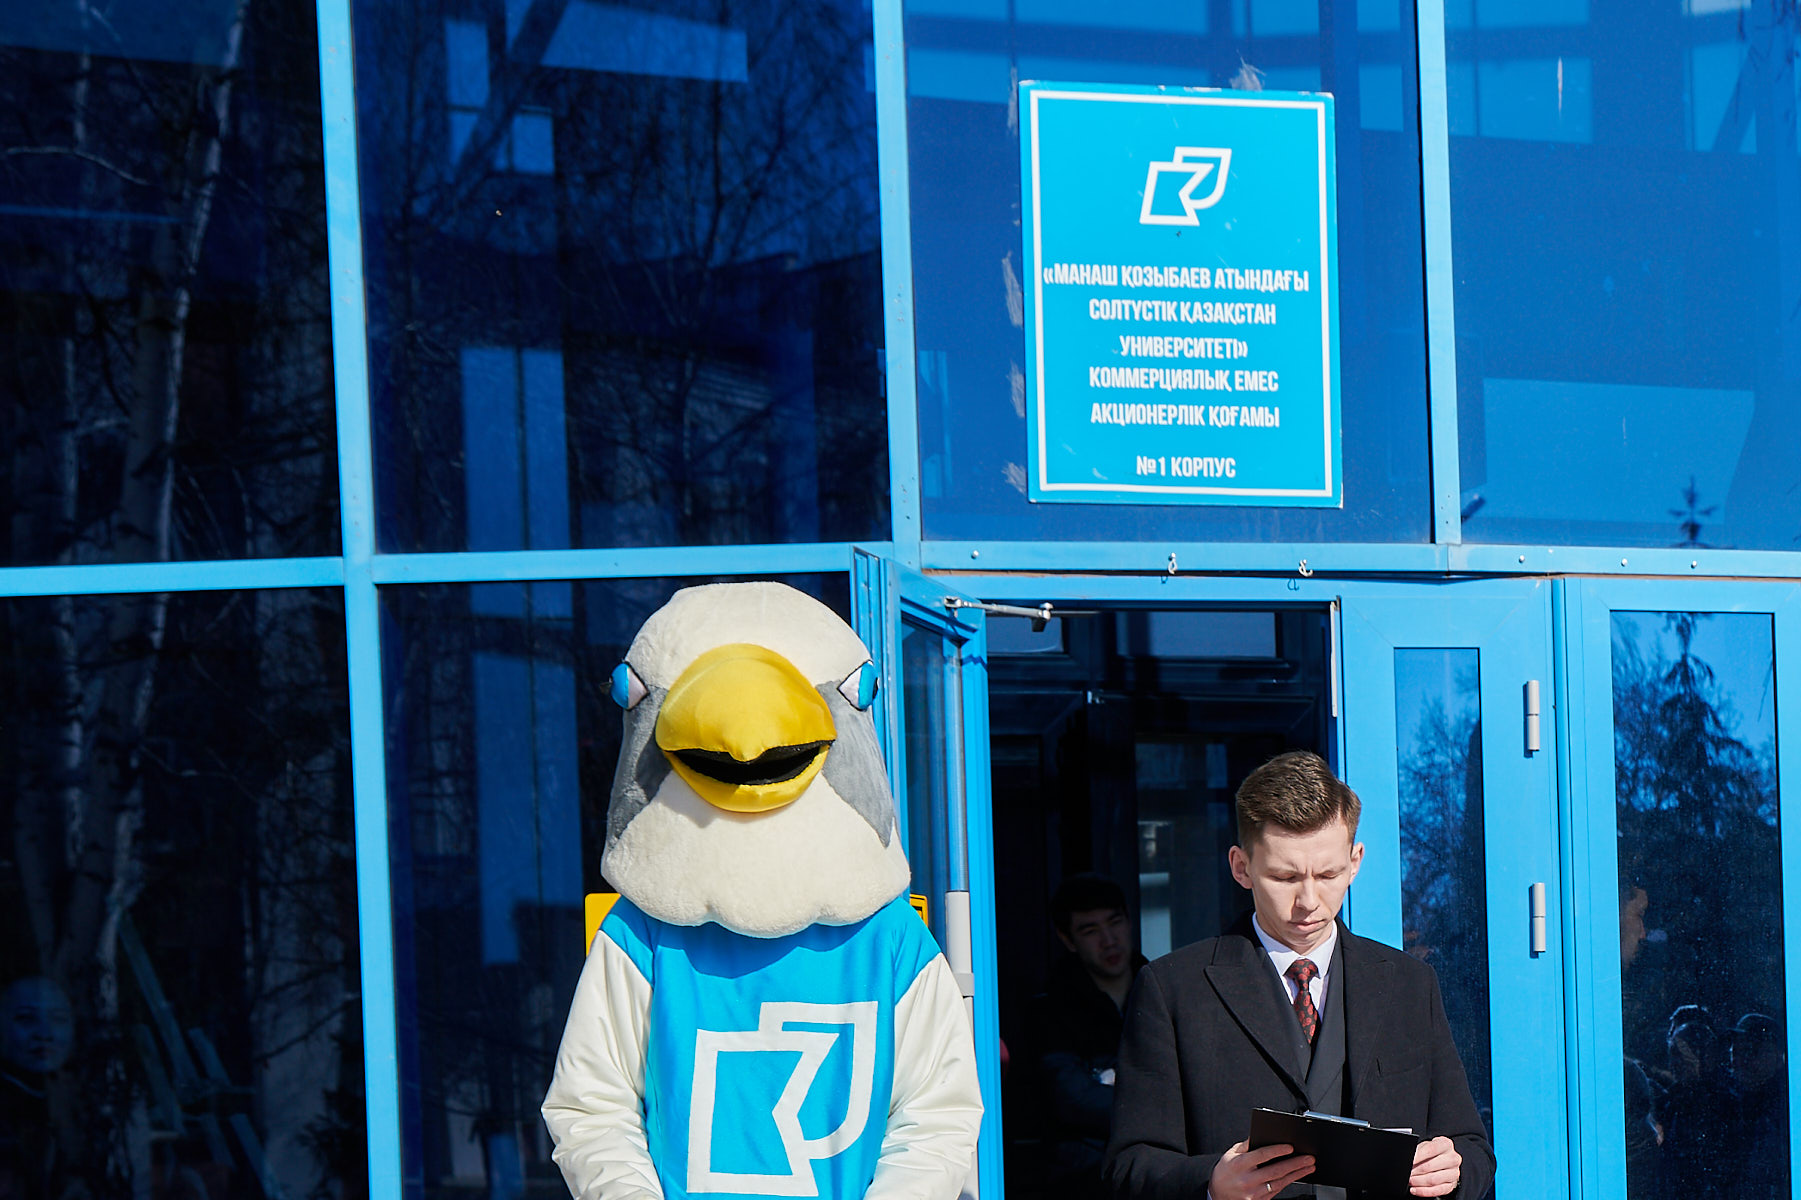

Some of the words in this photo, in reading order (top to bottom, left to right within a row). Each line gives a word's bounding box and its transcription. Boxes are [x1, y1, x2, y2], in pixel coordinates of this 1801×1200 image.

[1044, 263, 1118, 286] «МАНАШ
[1122, 266, 1211, 288] ҚОЗЫБАЕВ
[1215, 268, 1309, 293] АТЫНДАҒЫ
[1180, 302, 1276, 325] ҚАЗАҚСТАН
[1090, 367, 1232, 392] КОММЕРЦИЯЛЫҚ
[1235, 370, 1278, 391] ЕМЕС
[1091, 403, 1205, 426] АКЦИОНЕРЛІК
[1209, 406, 1280, 427] ҚОҒАМЫ
[1171, 457, 1236, 477] КОРПУС
